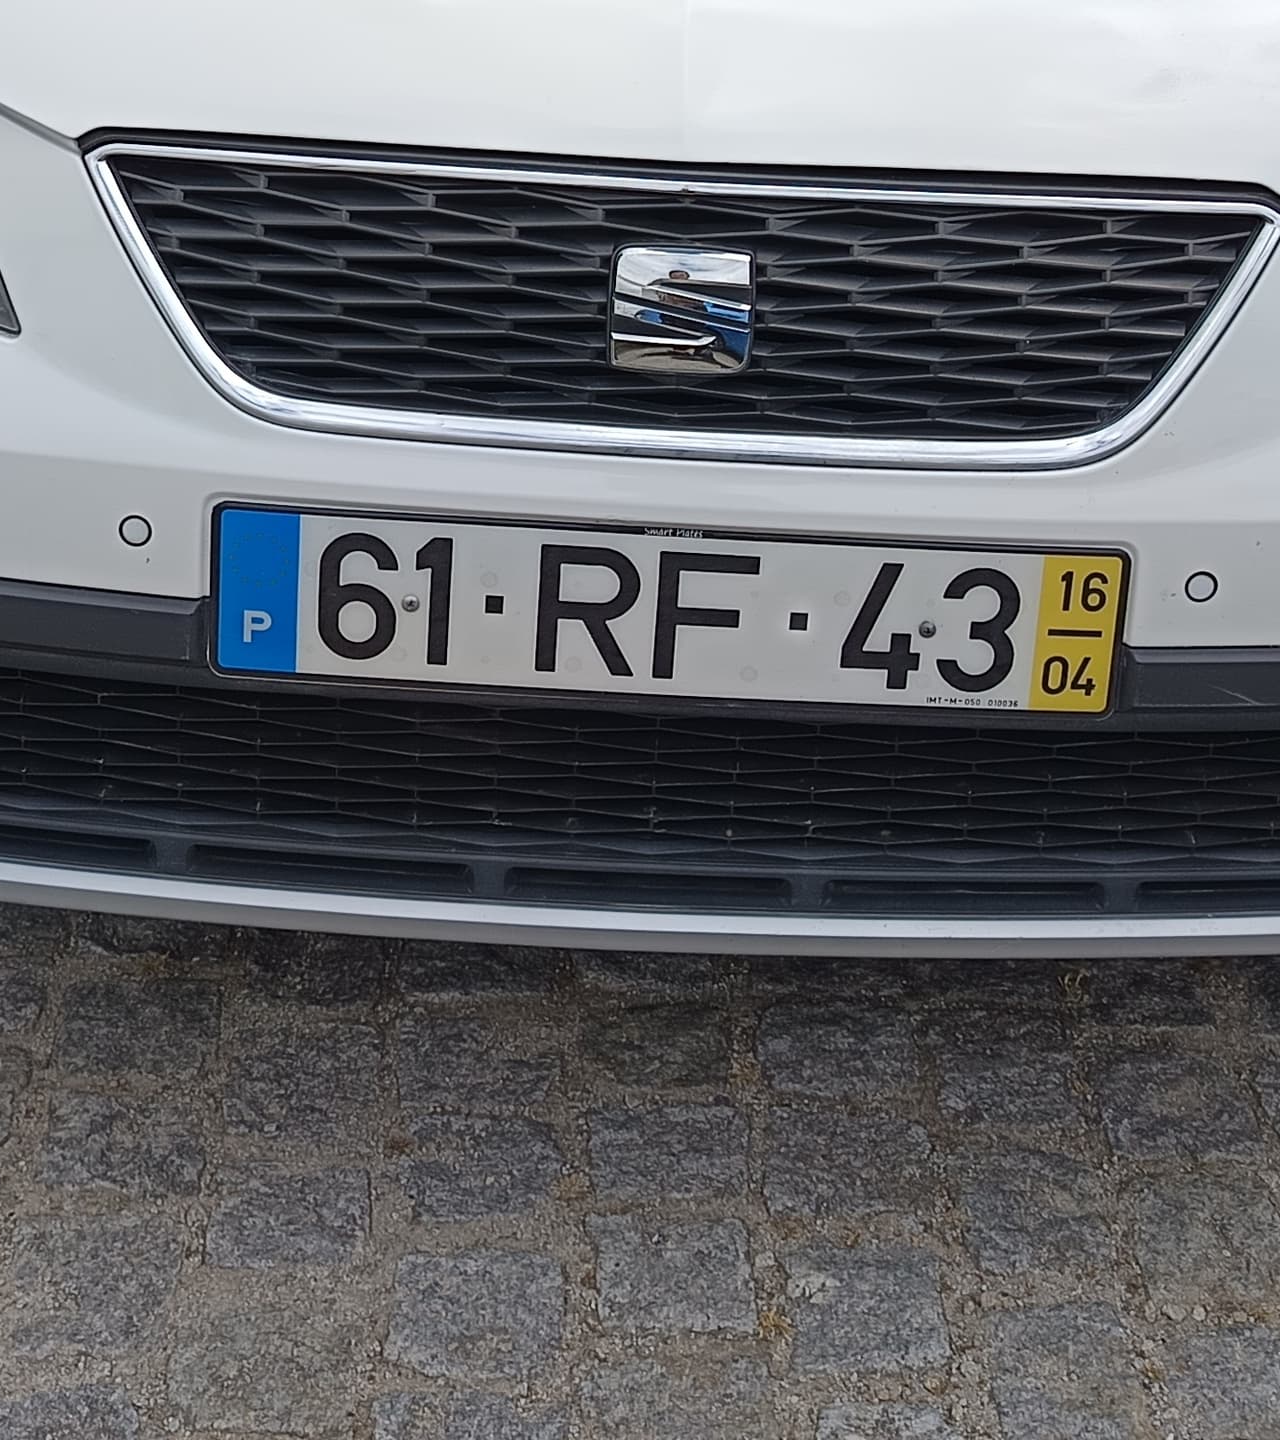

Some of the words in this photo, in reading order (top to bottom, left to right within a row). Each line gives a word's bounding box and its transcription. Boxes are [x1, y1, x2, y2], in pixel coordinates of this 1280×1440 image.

[1060, 570, 1109, 612] 16
[243, 610, 272, 643] P
[1041, 656, 1096, 697] 04
